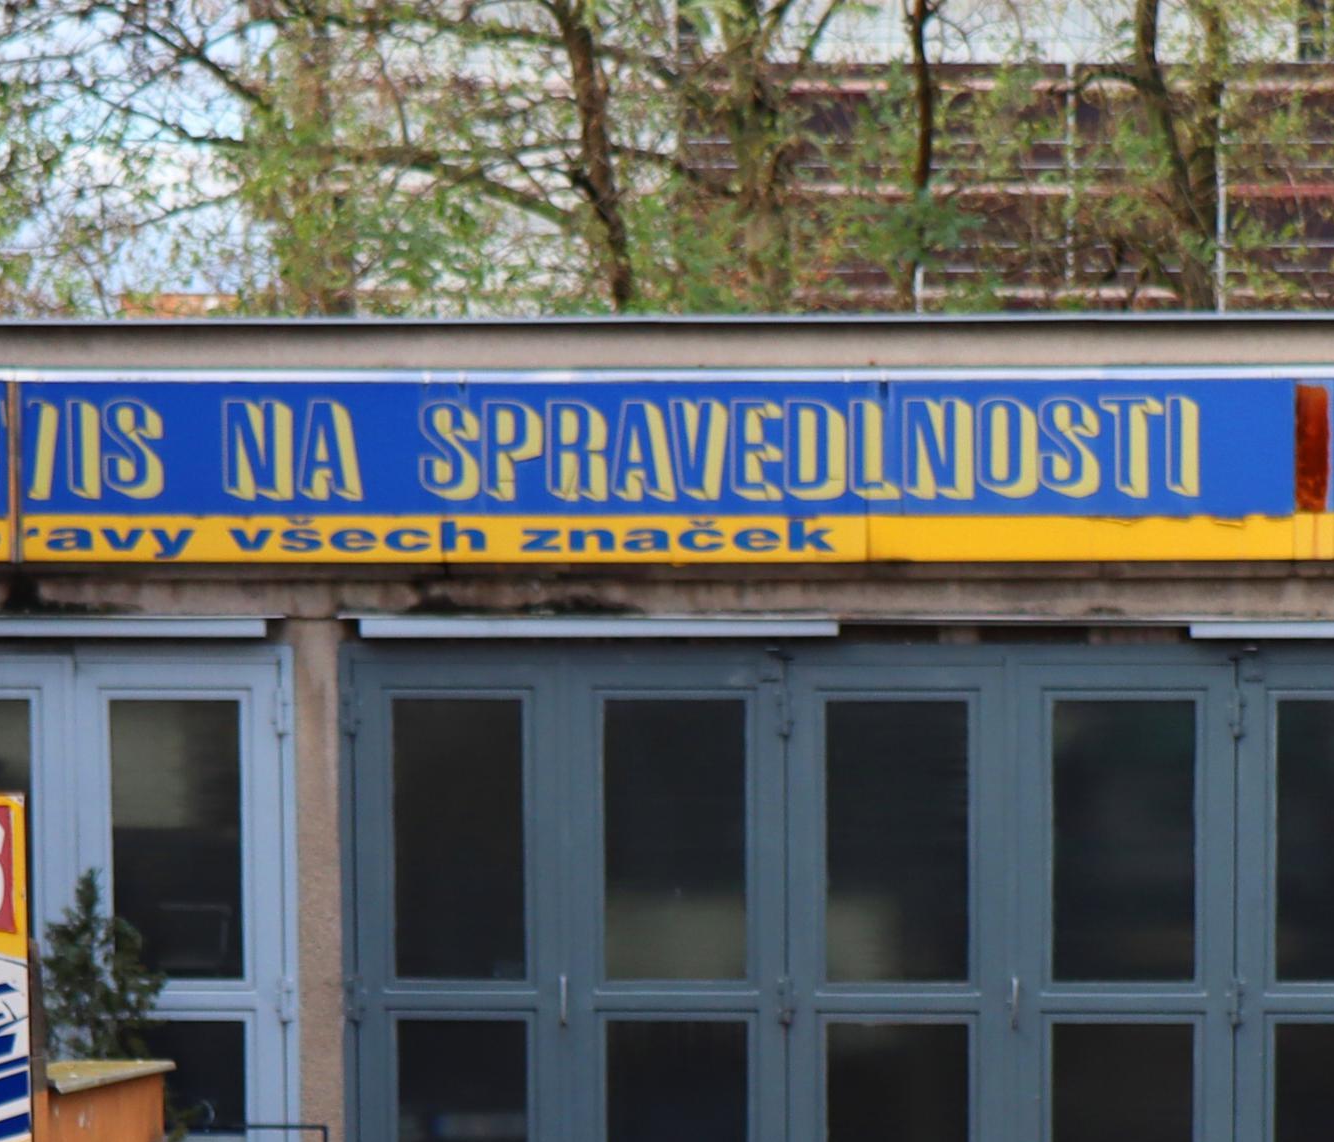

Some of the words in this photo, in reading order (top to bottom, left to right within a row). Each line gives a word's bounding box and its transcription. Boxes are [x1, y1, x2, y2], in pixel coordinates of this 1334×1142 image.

[221, 398, 364, 502] NA
[418, 397, 1200, 502] SPRAVEDLNOSTI
[228, 520, 487, 553] všech
[521, 520, 838, 553] značek
